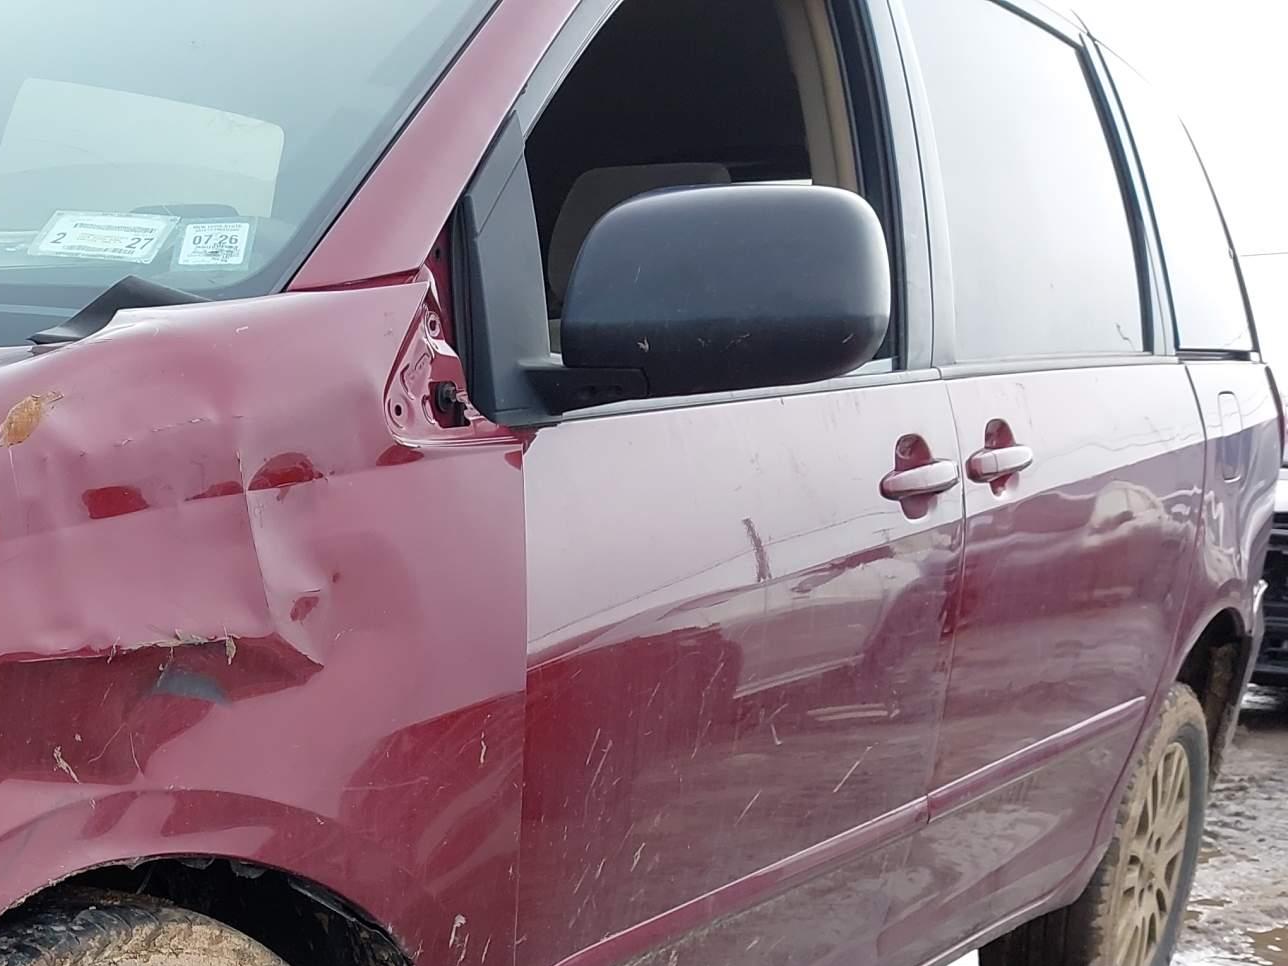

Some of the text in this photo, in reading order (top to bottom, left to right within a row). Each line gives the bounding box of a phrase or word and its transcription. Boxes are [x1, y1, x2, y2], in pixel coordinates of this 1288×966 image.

[50, 232, 66, 244] 2
[125, 237, 155, 250] 27
[192, 234, 239, 246] 07 26
